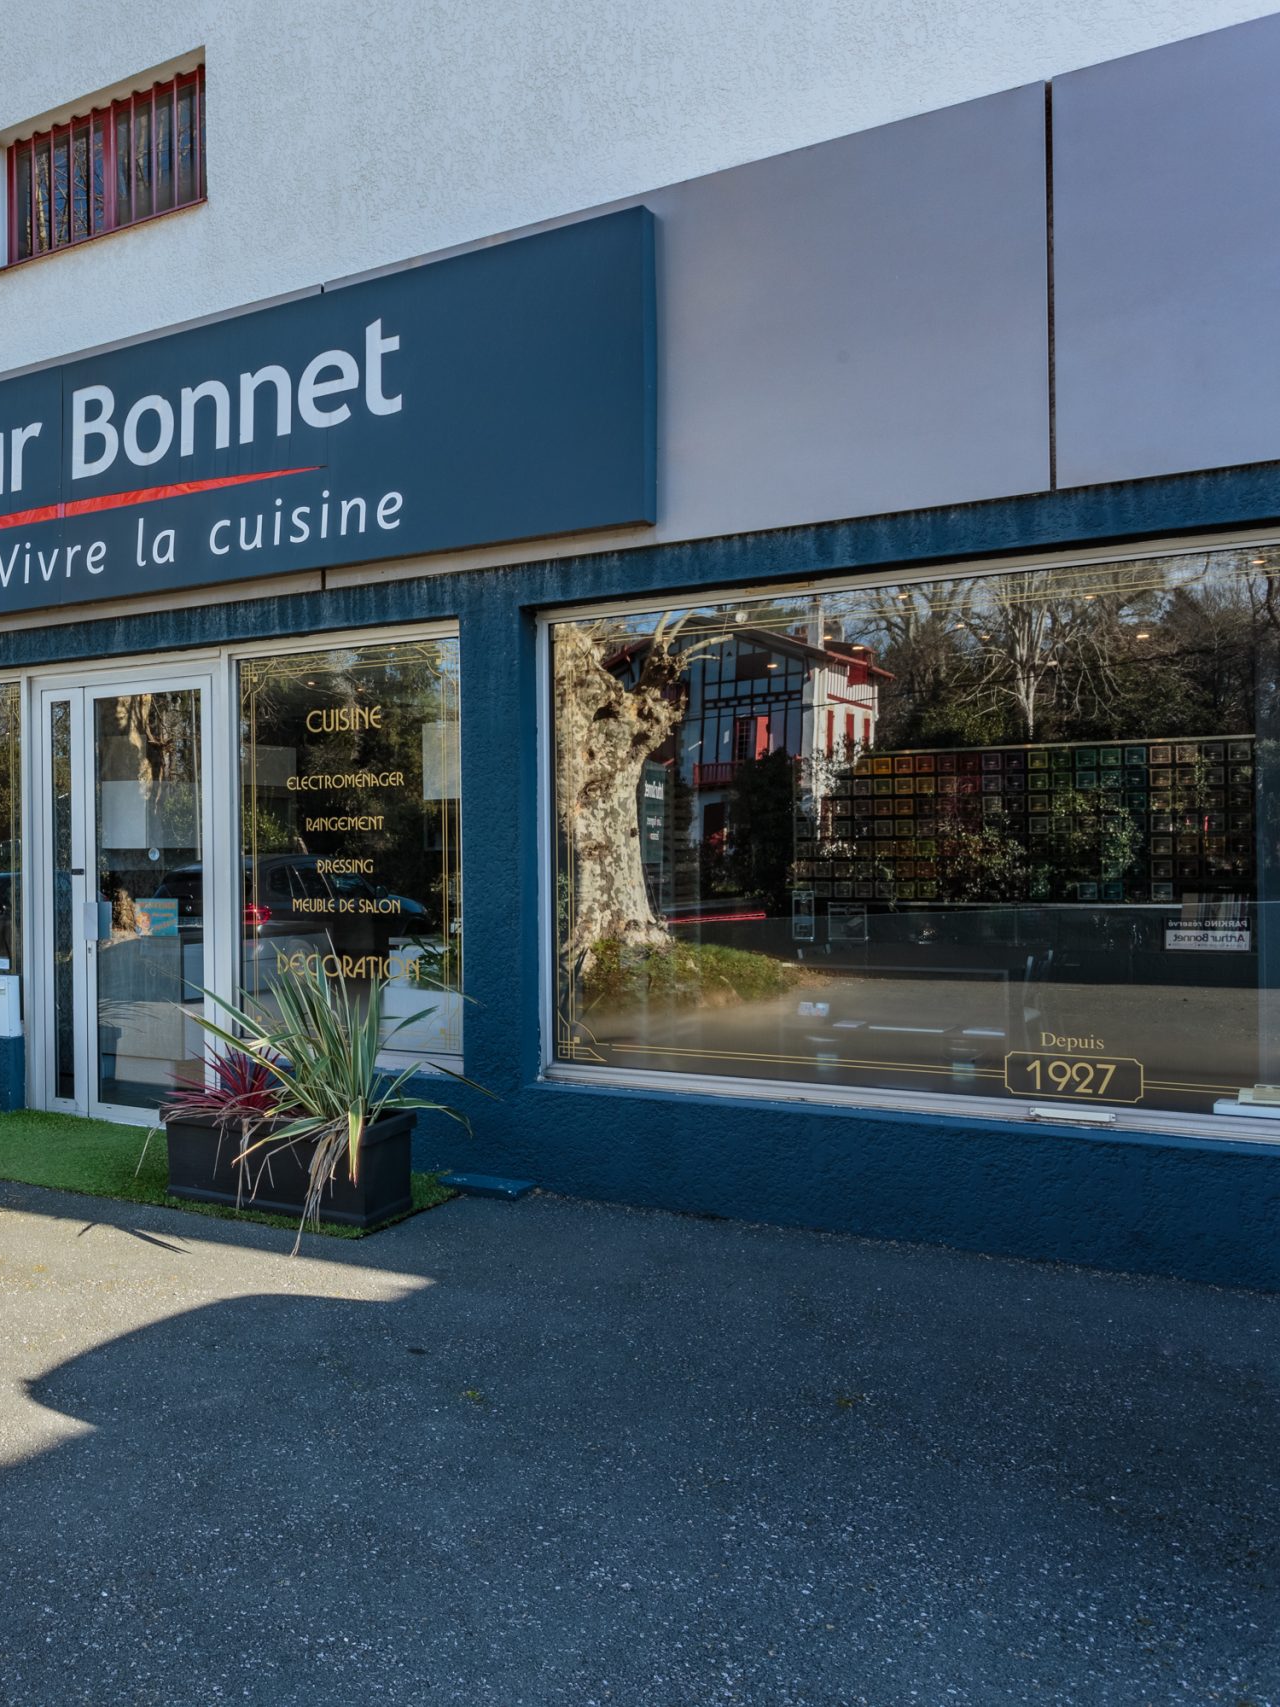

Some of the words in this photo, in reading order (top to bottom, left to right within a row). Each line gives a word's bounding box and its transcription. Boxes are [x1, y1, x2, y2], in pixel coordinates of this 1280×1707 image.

[71, 318, 402, 480] Bonnet
[136, 517, 176, 567] la
[209, 490, 404, 555] cuisine
[306, 705, 382, 733] CUISINE
[306, 816, 384, 831] RANGEMENT
[317, 859, 374, 873] DRESSING
[292, 898, 335, 912] MEUBLE
[340, 898, 355, 912] DE
[359, 899, 401, 913] SALON
[1040, 1032, 1105, 1051] Depuis
[1026, 1060, 1116, 1094] 1927
